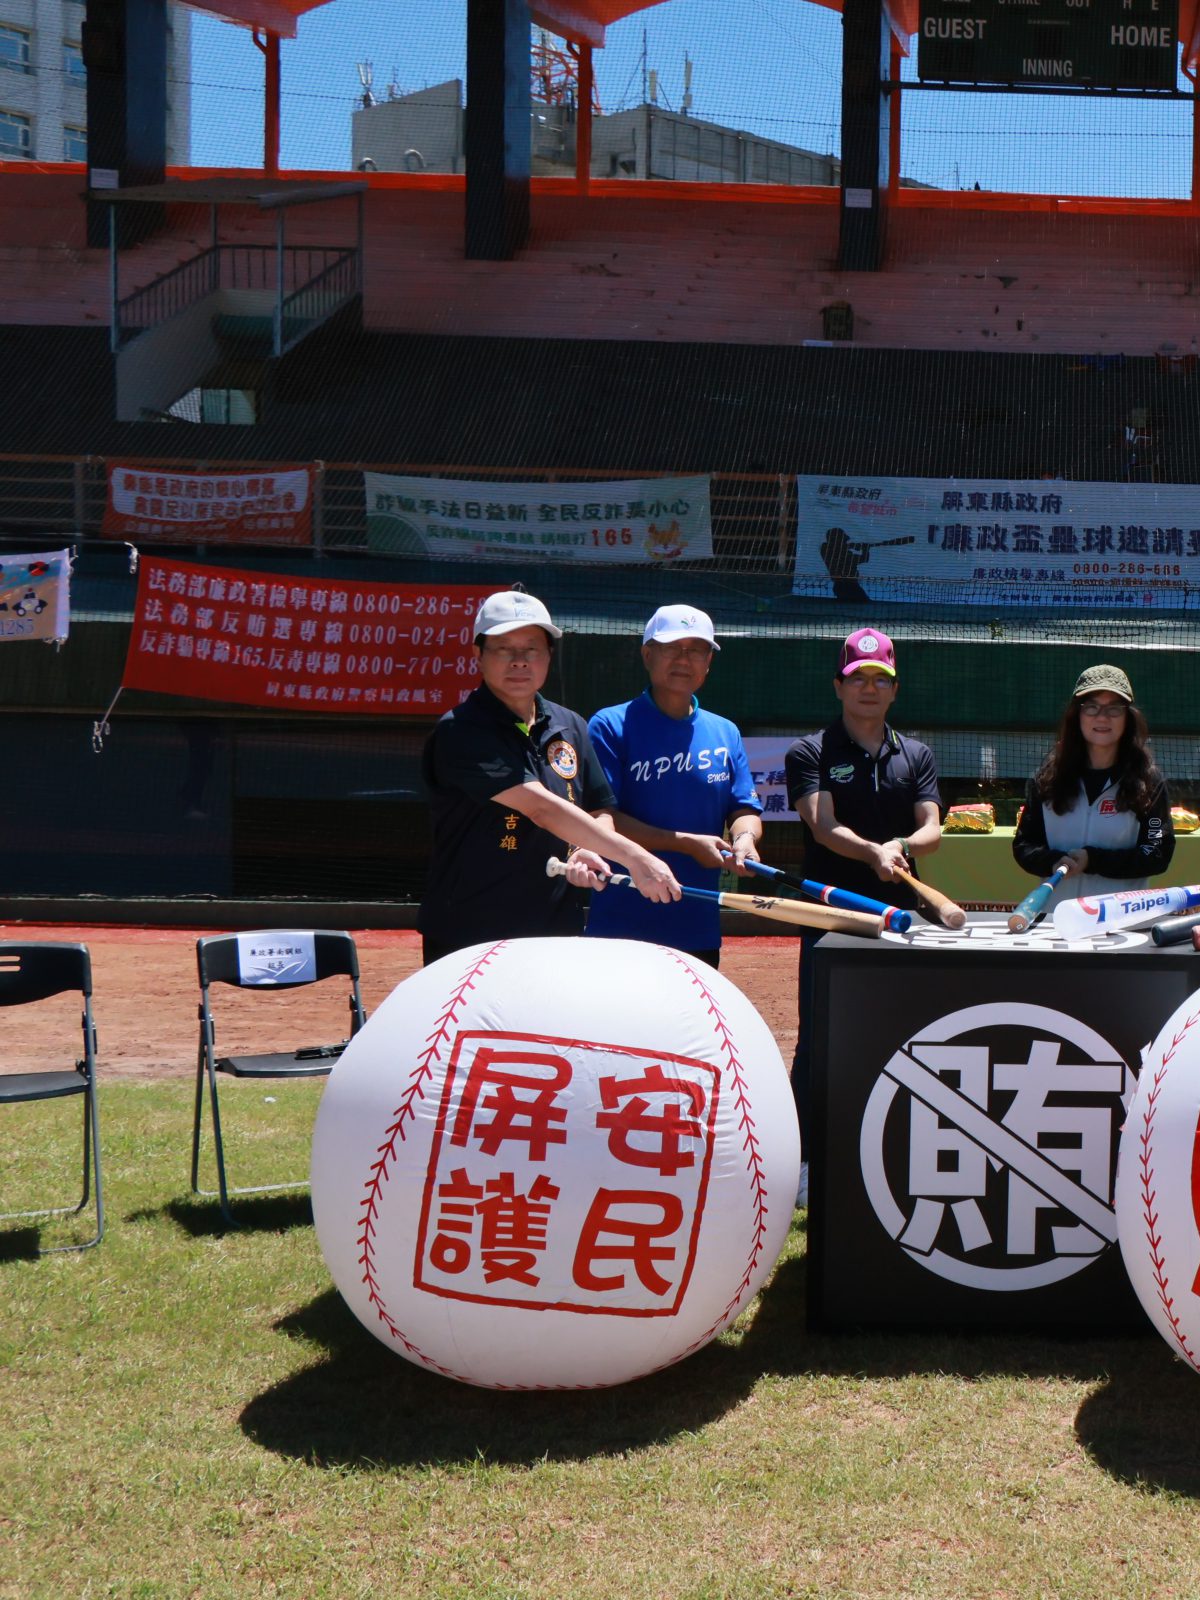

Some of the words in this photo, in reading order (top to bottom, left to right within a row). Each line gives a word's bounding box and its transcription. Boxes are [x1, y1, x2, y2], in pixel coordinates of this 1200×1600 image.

[923, 17, 987, 40] GUEST
[1110, 25, 1172, 48] HOME
[1022, 59, 1073, 77] INNING
[537, 499, 690, 521] 全民反詐要小心
[941, 491, 1062, 514] 屏東縣政府
[592, 528, 632, 547] 165
[148, 568, 348, 613] 法務部廉政署檢舉專線
[144, 599, 344, 644] 法務部反賄選專線
[629, 746, 729, 782] NPUST
[707, 771, 731, 784] EMBA
[499, 813, 520, 851] 吉雄
[1121, 893, 1171, 915] Taipei
